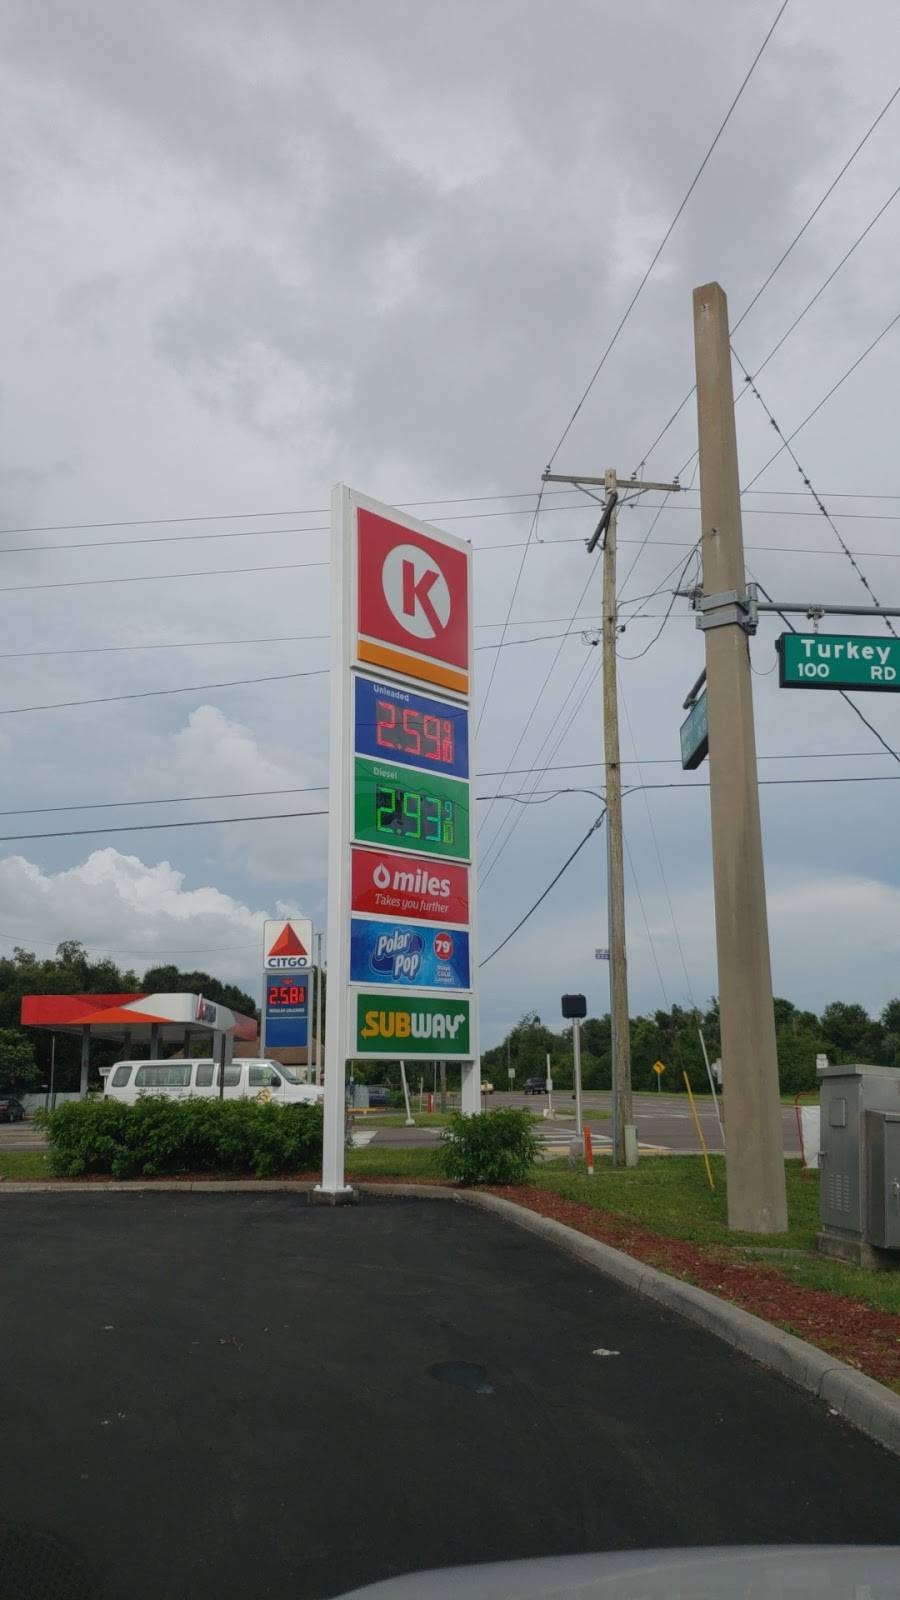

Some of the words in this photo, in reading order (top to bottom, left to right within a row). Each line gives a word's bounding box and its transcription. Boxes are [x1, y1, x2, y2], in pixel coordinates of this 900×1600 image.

[402, 559, 446, 638] K
[800, 639, 891, 664] Turkey
[797, 663, 830, 678] 100
[870, 666, 896, 681] RD
[373, 684, 410, 701] Unleaded
[373, 766, 398, 780] Diesel
[393, 868, 451, 898] miles
[375, 893, 401, 907] Takes
[401, 899, 419, 910] you
[419, 899, 449, 913] further
[378, 931, 410, 955] Polar
[267, 957, 308, 968] CITGO
[395, 954, 419, 976] Pop
[361, 1010, 466, 1039] SUBWAY
